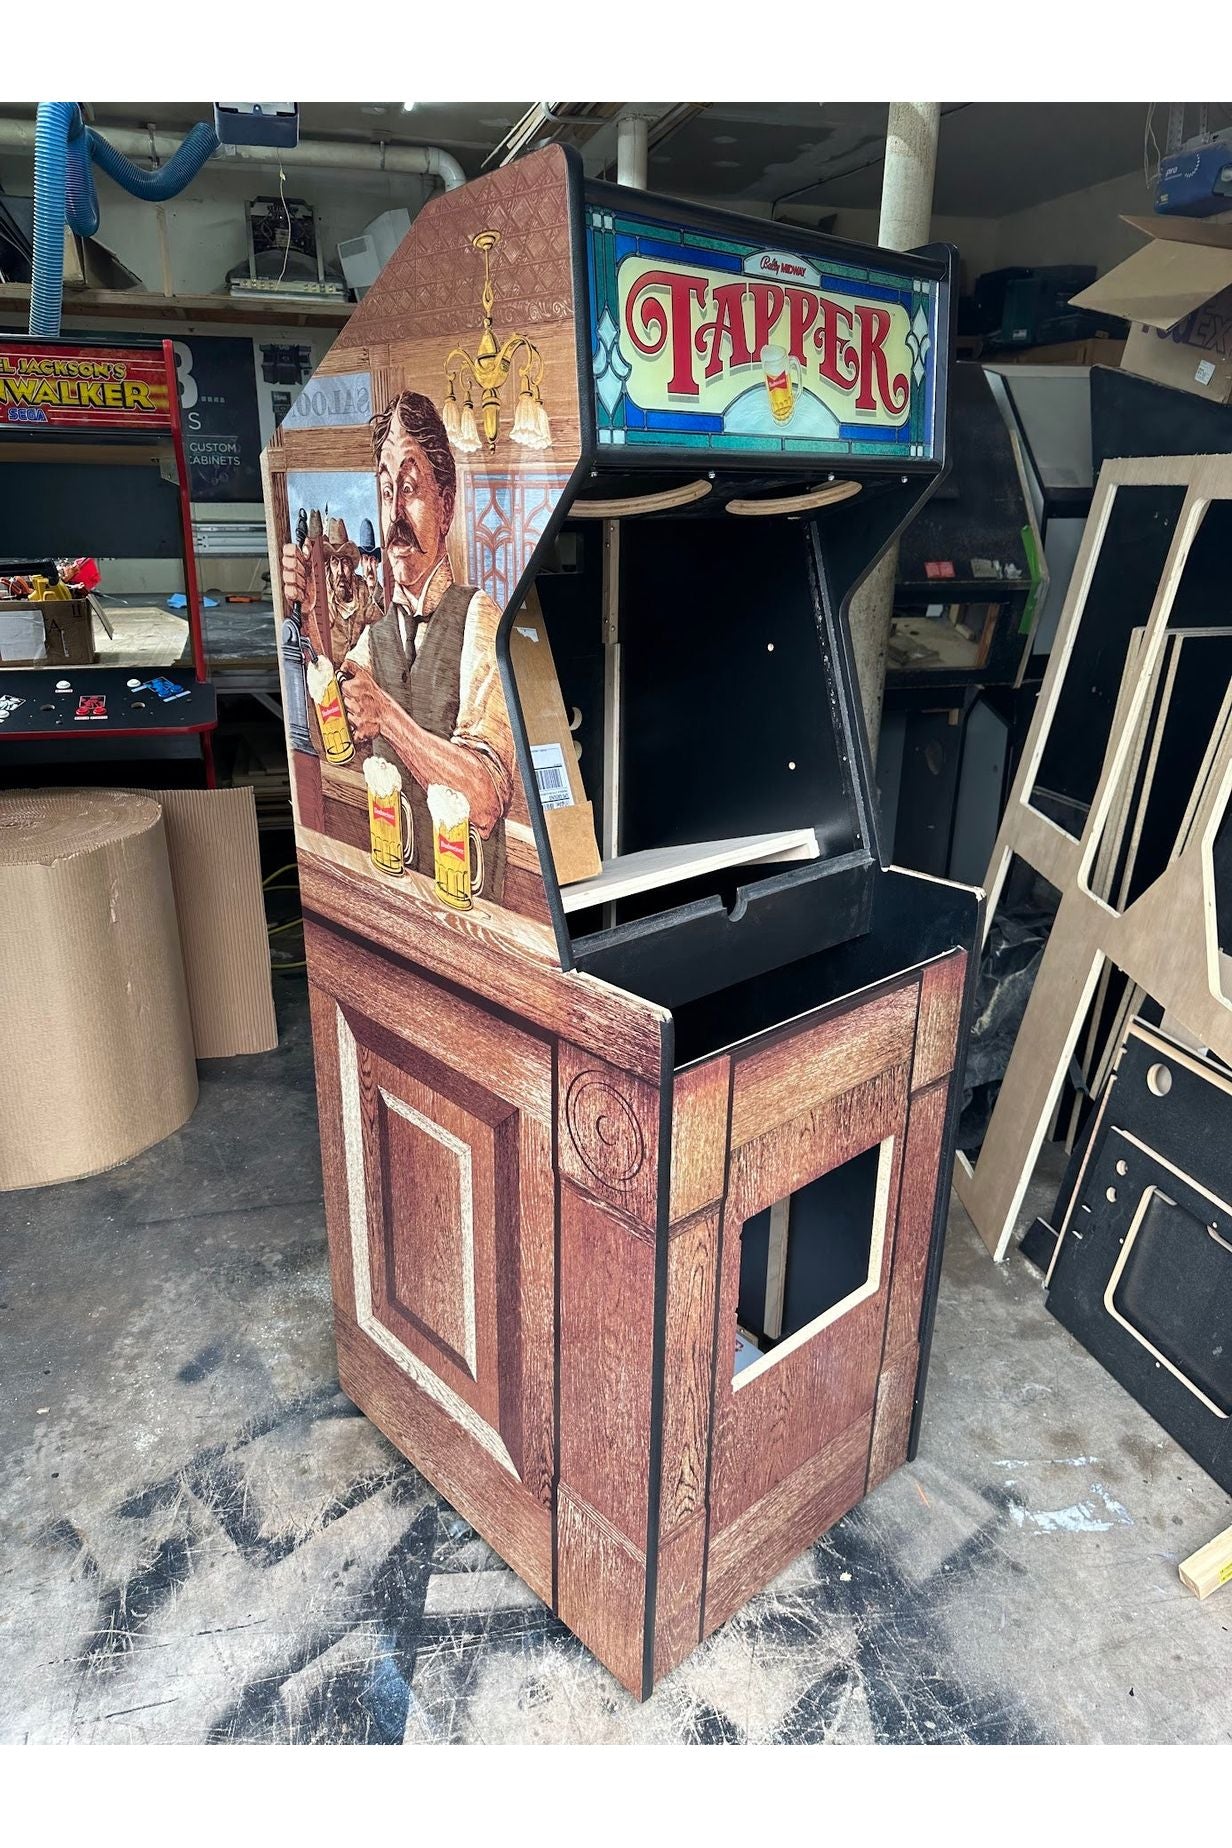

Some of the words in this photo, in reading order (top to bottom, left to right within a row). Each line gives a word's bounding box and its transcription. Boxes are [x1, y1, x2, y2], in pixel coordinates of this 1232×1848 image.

[760, 255, 780, 275] Bally
[781, 262, 807, 278] MIDWAY
[625, 270, 910, 415] TAPPER
[17, 357, 127, 382] JACKSON'S
[8, 407, 48, 423] SEGA
[189, 442, 237, 453] CUSTOM
